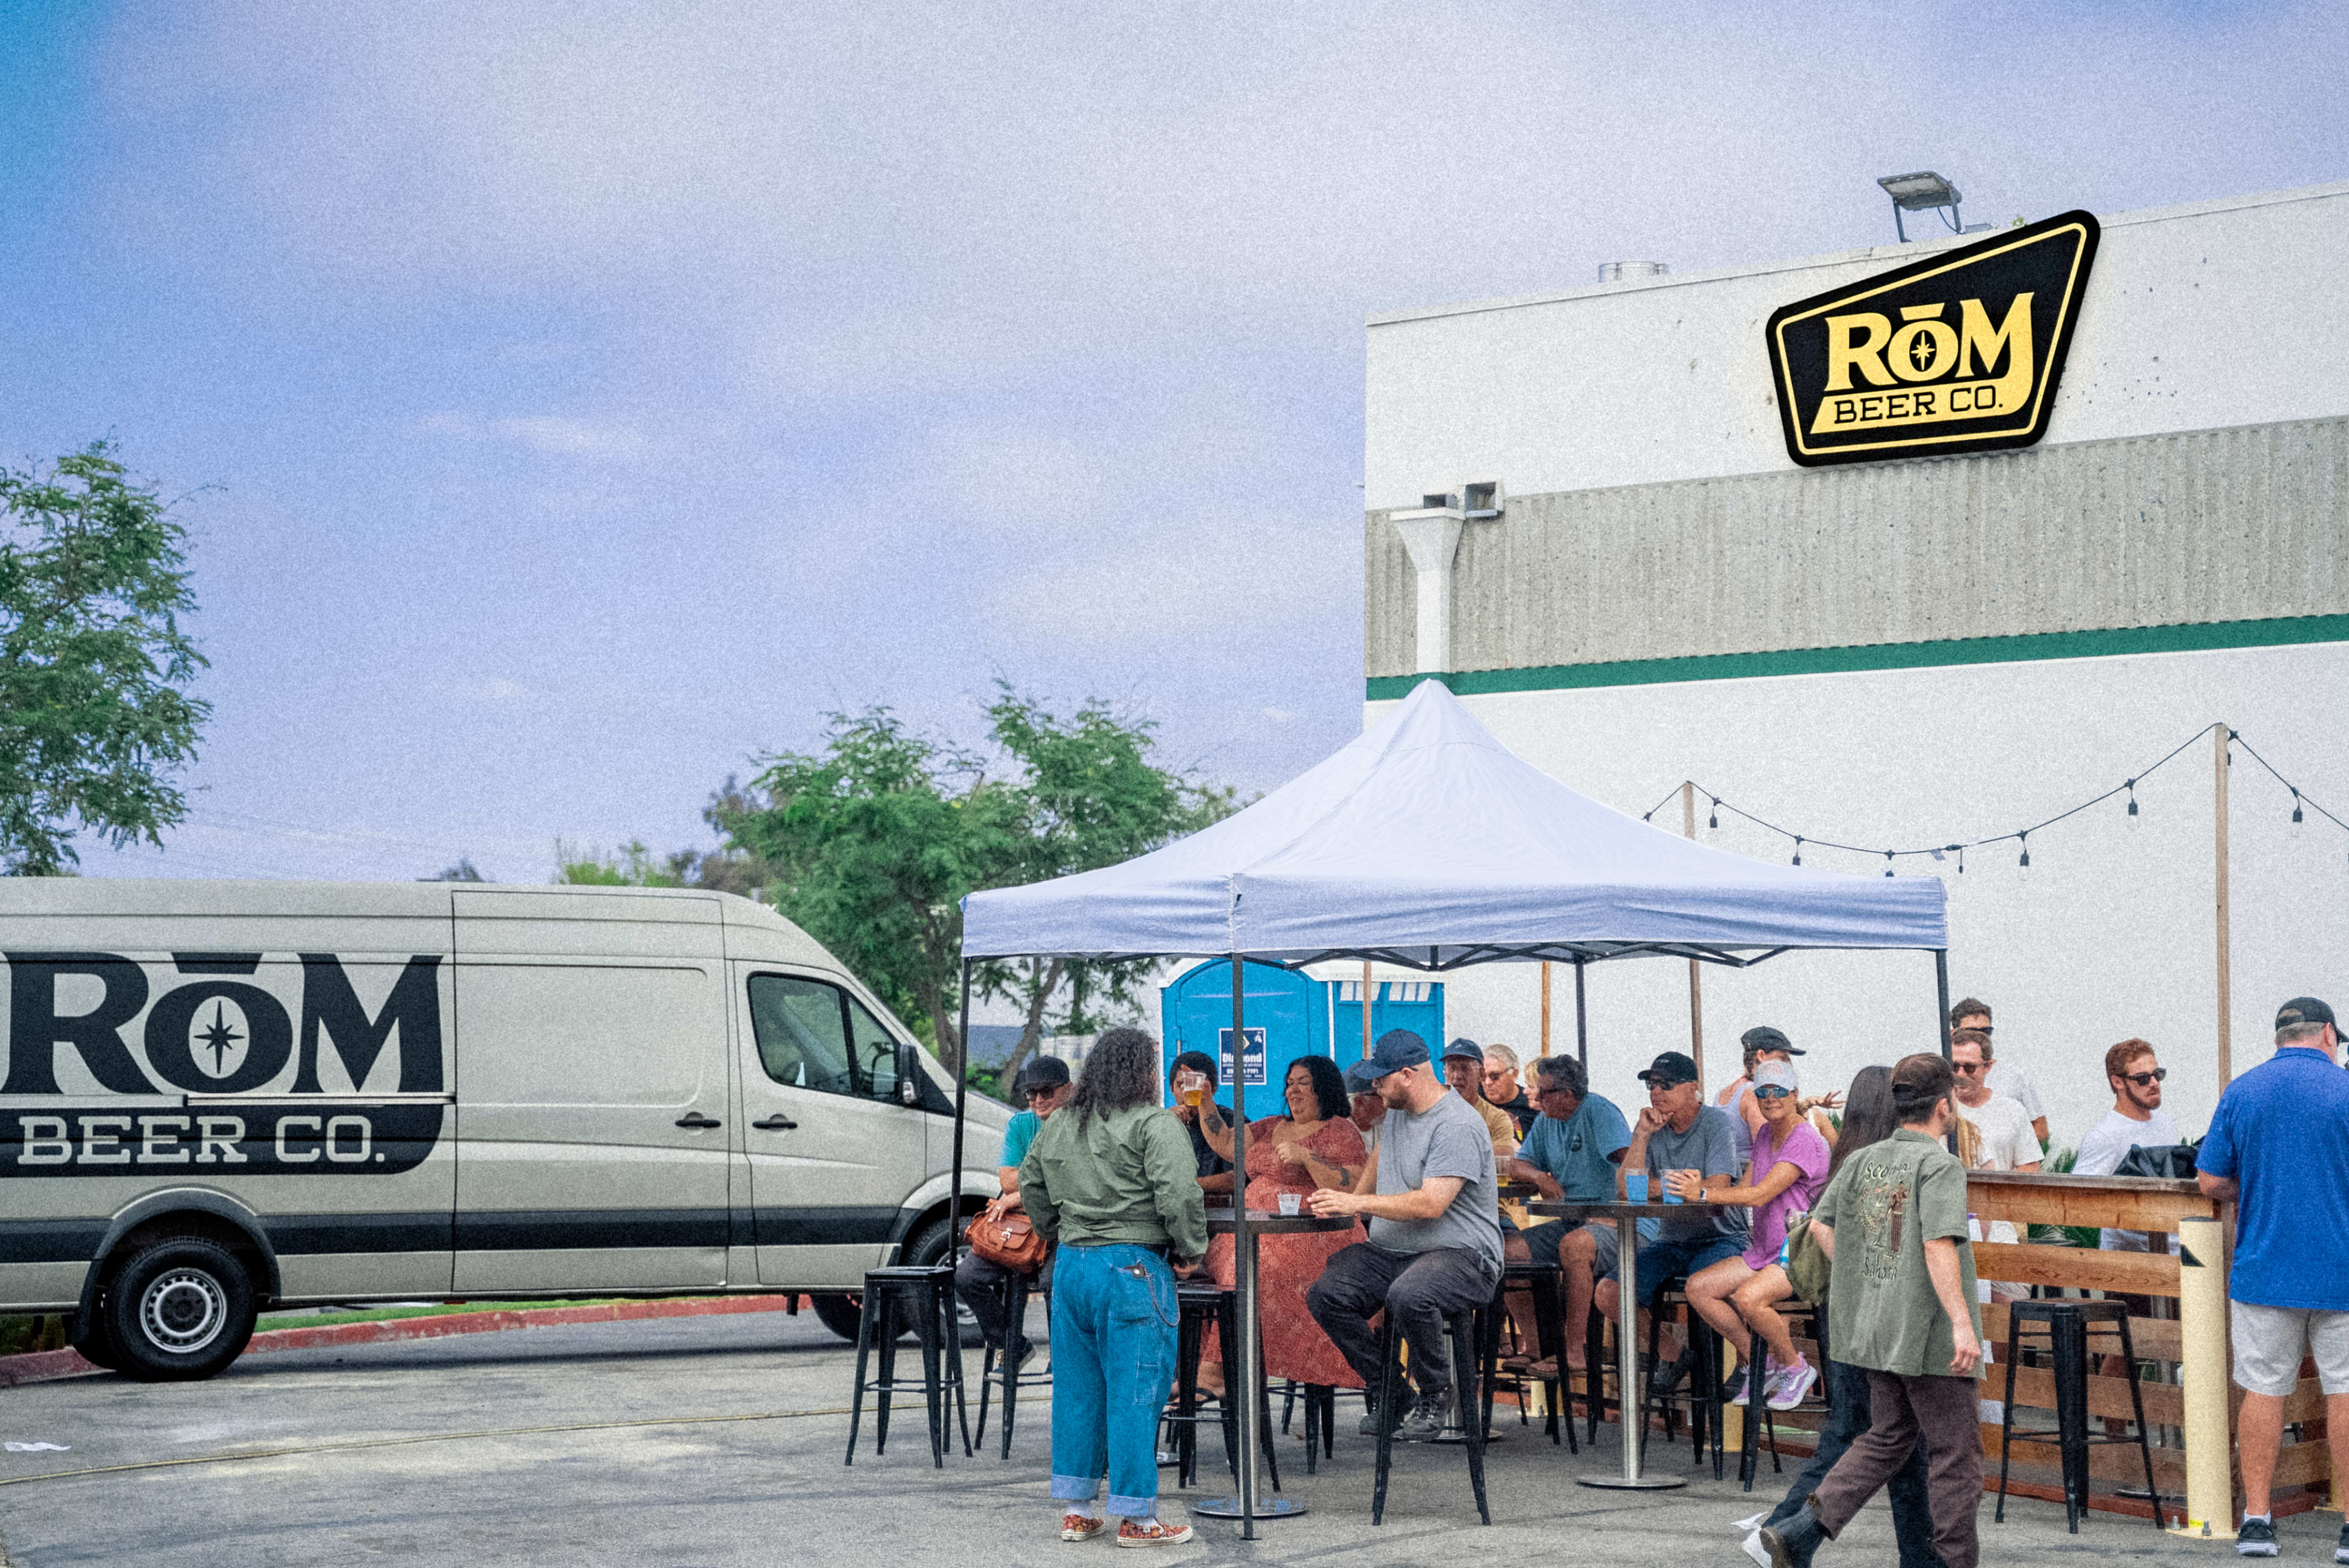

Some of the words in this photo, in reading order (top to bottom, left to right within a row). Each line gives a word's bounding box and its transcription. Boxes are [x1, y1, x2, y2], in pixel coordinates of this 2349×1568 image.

[1833, 391, 1936, 424] BEER
[1950, 385, 2003, 412] CO.
[1222, 1052, 1263, 1063] Diond
[17, 1115, 248, 1164] BEER
[275, 1115, 385, 1163] CO.
